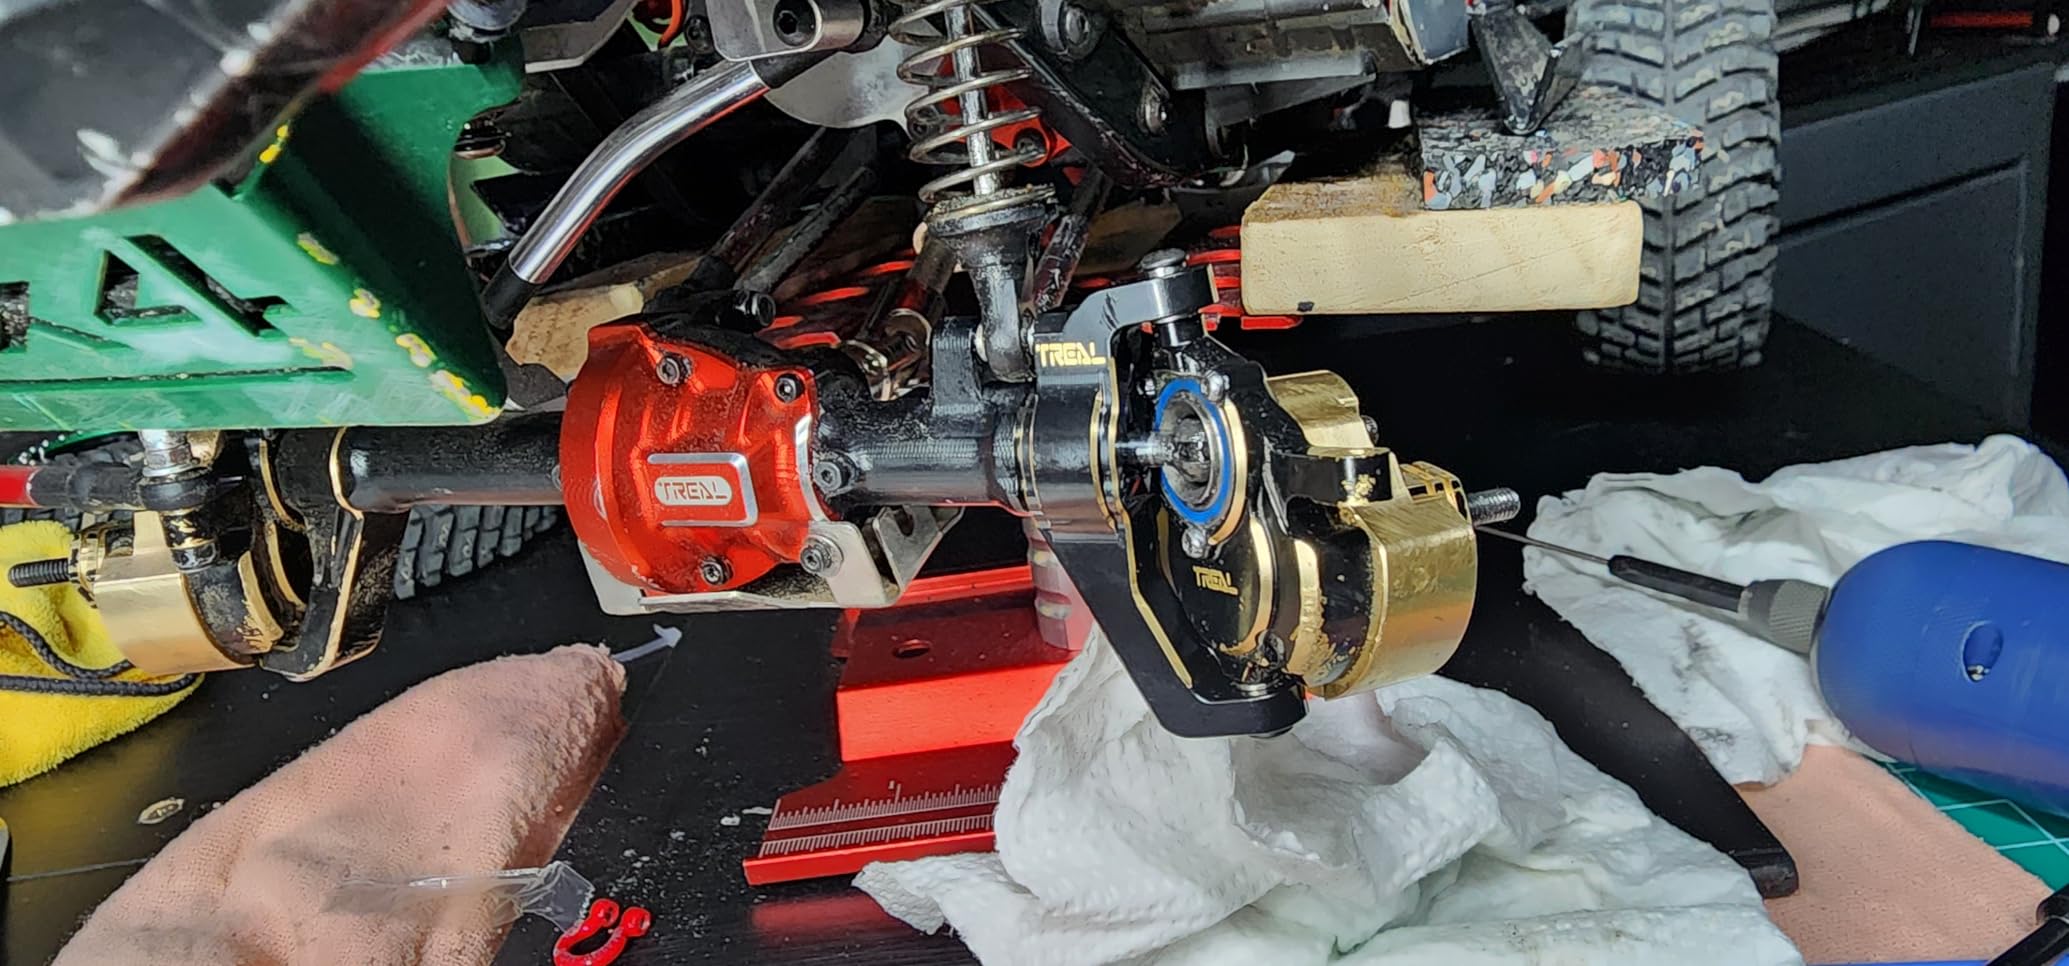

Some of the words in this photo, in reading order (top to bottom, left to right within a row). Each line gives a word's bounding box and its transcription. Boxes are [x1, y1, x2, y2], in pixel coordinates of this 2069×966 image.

[1035, 341, 1106, 367] TREAL
[658, 481, 728, 500] TREAL
[1192, 565, 1239, 596] TREAL
